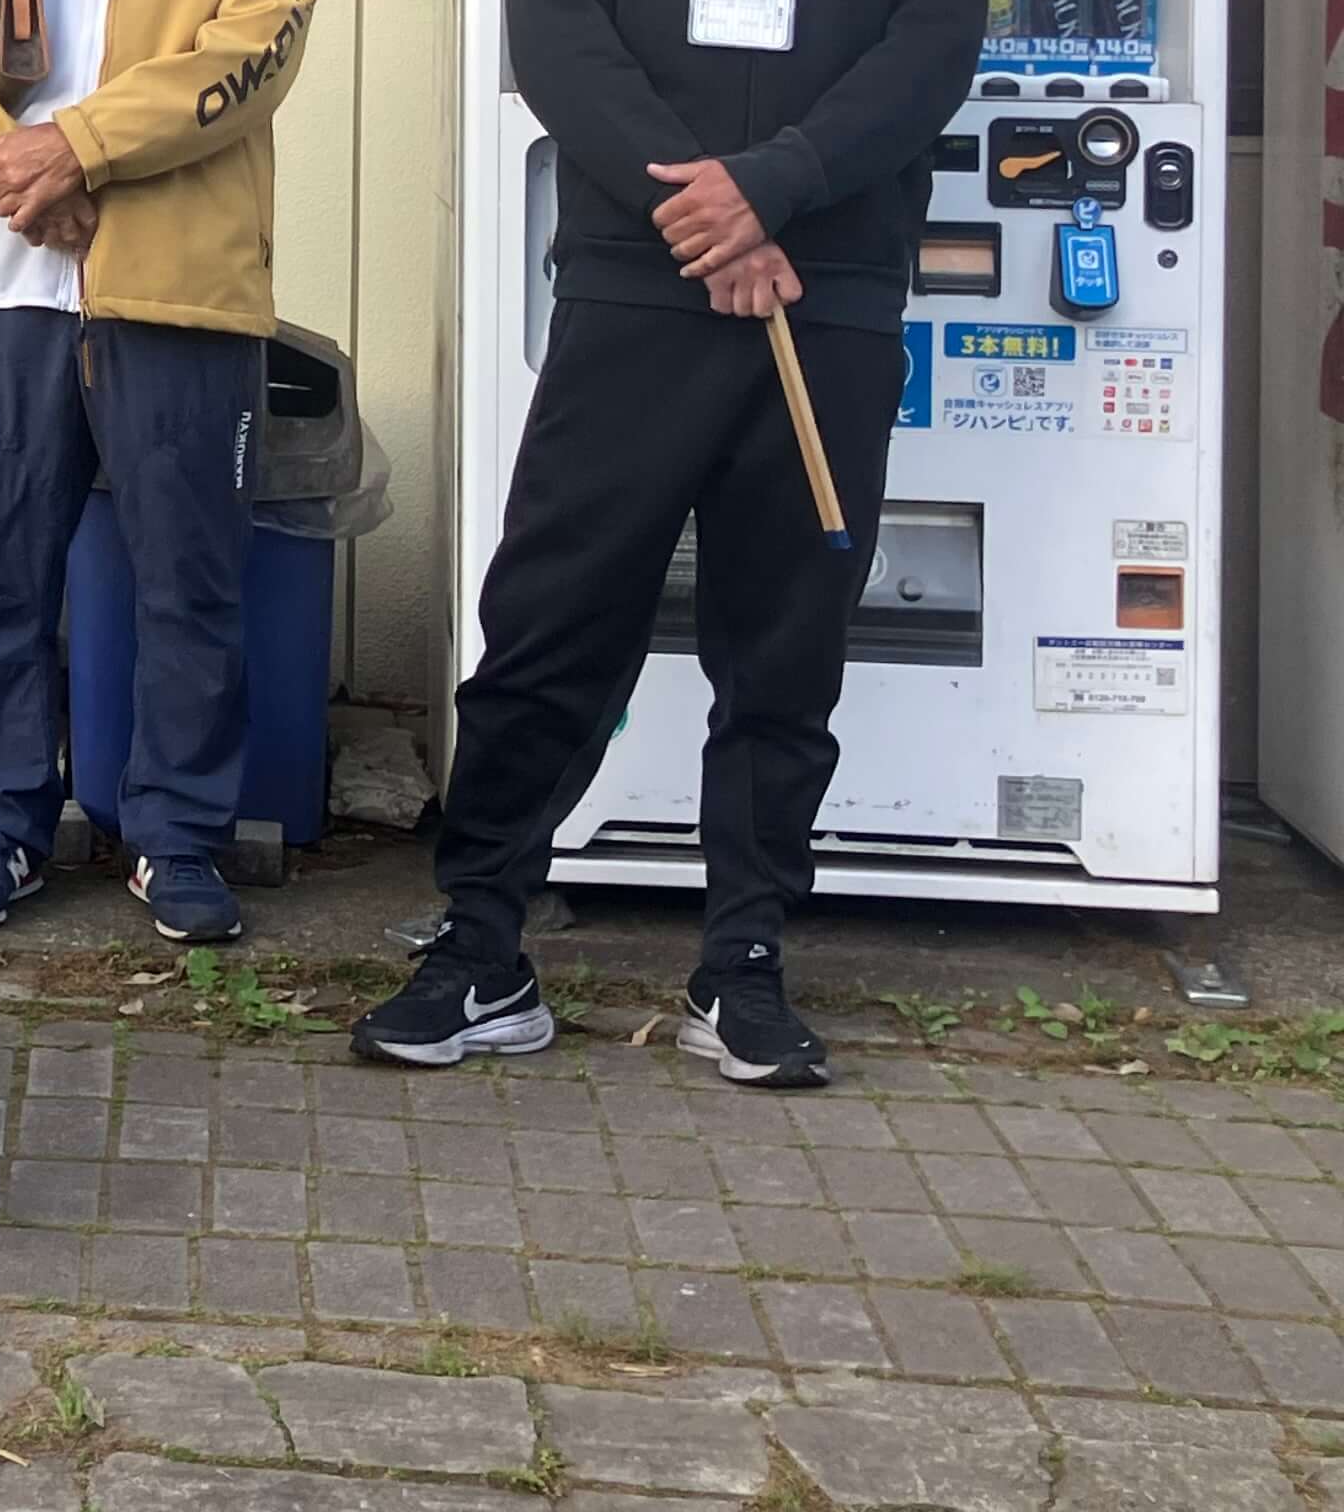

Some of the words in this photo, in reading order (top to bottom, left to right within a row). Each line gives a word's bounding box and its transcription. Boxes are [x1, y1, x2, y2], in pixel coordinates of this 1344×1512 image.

[983, 38, 1028, 55] 40円
[1032, 38, 1089, 55] 140円
[1096, 39, 1153, 55] 140円
